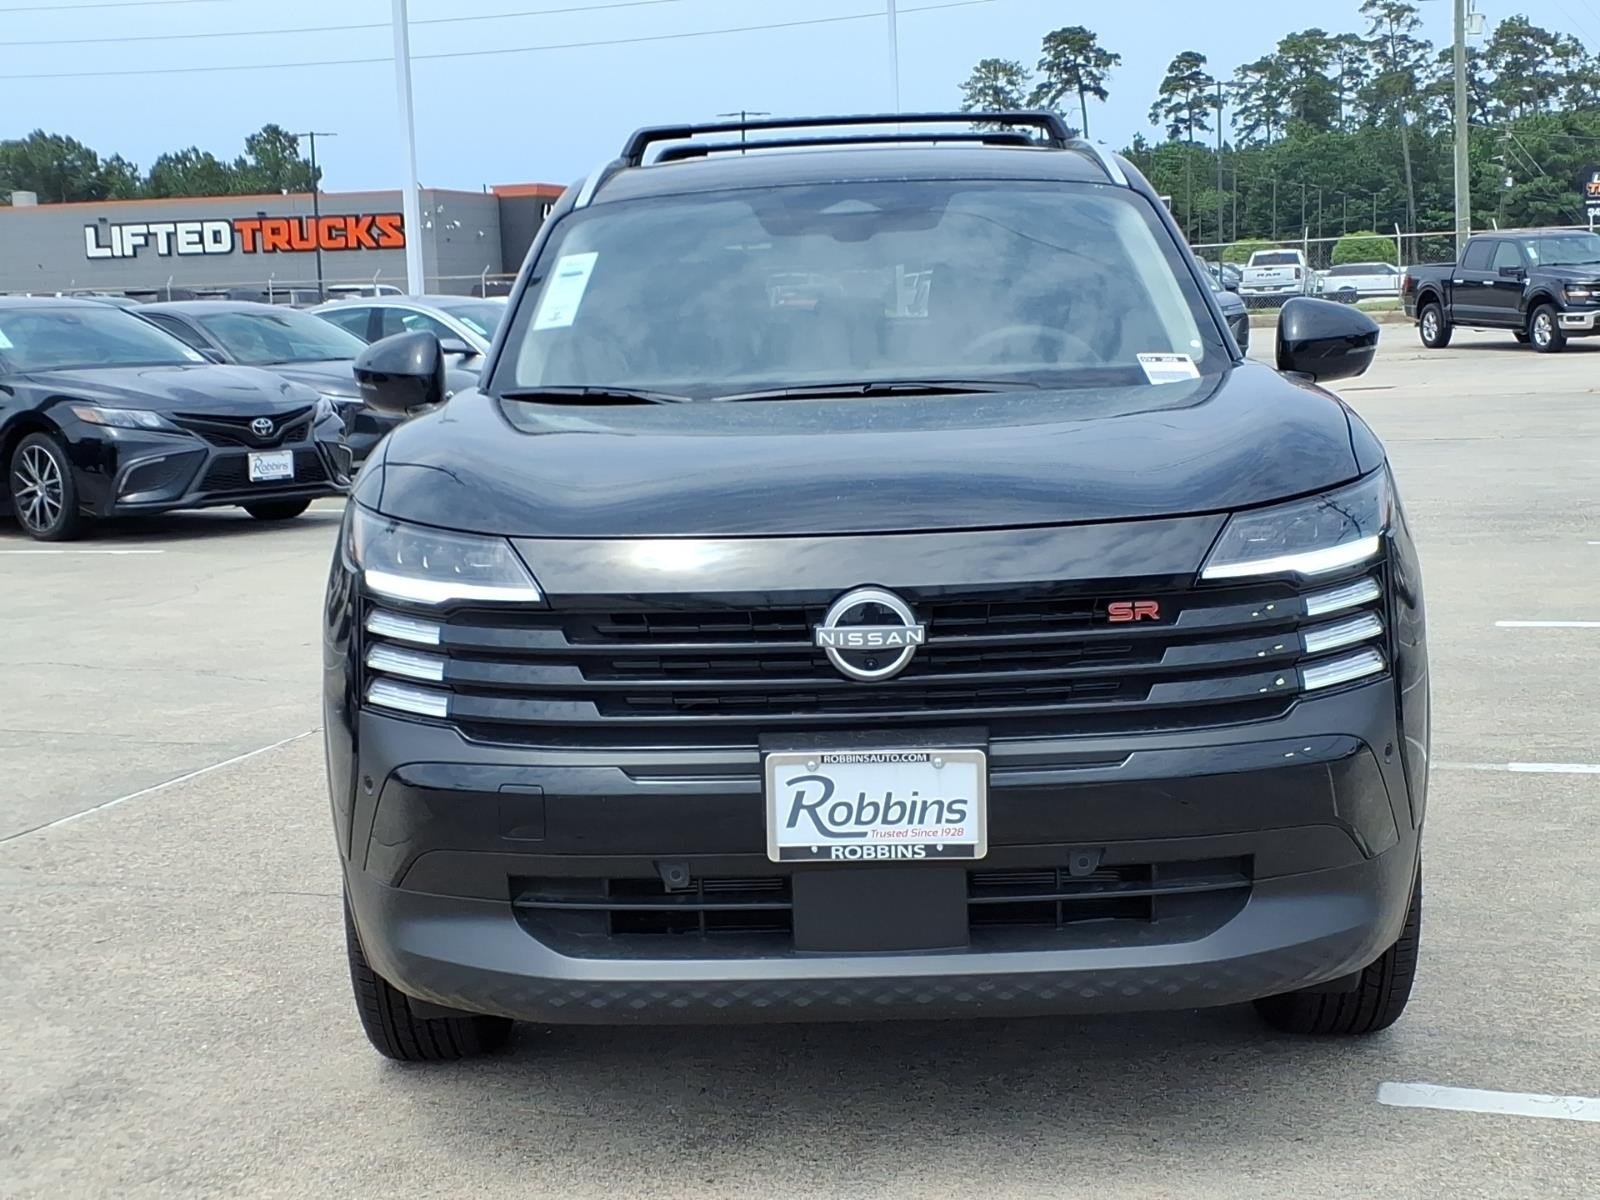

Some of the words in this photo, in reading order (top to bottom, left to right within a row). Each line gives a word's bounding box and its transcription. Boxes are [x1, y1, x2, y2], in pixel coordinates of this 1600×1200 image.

[84, 219, 232, 259] LIFTED
[232, 213, 405, 253] TRUCKS
[253, 456, 289, 474] Robbins
[1108, 600, 1160, 621] SR
[819, 629, 923, 647] NISSAN
[823, 753, 928, 764] ROBBINSAUTO.COM
[785, 775, 968, 838] Robbins
[871, 829, 909, 838] Trusted
[910, 828, 939, 837] Since
[941, 827, 964, 837] 1928
[831, 845, 926, 859] ROBBINS
